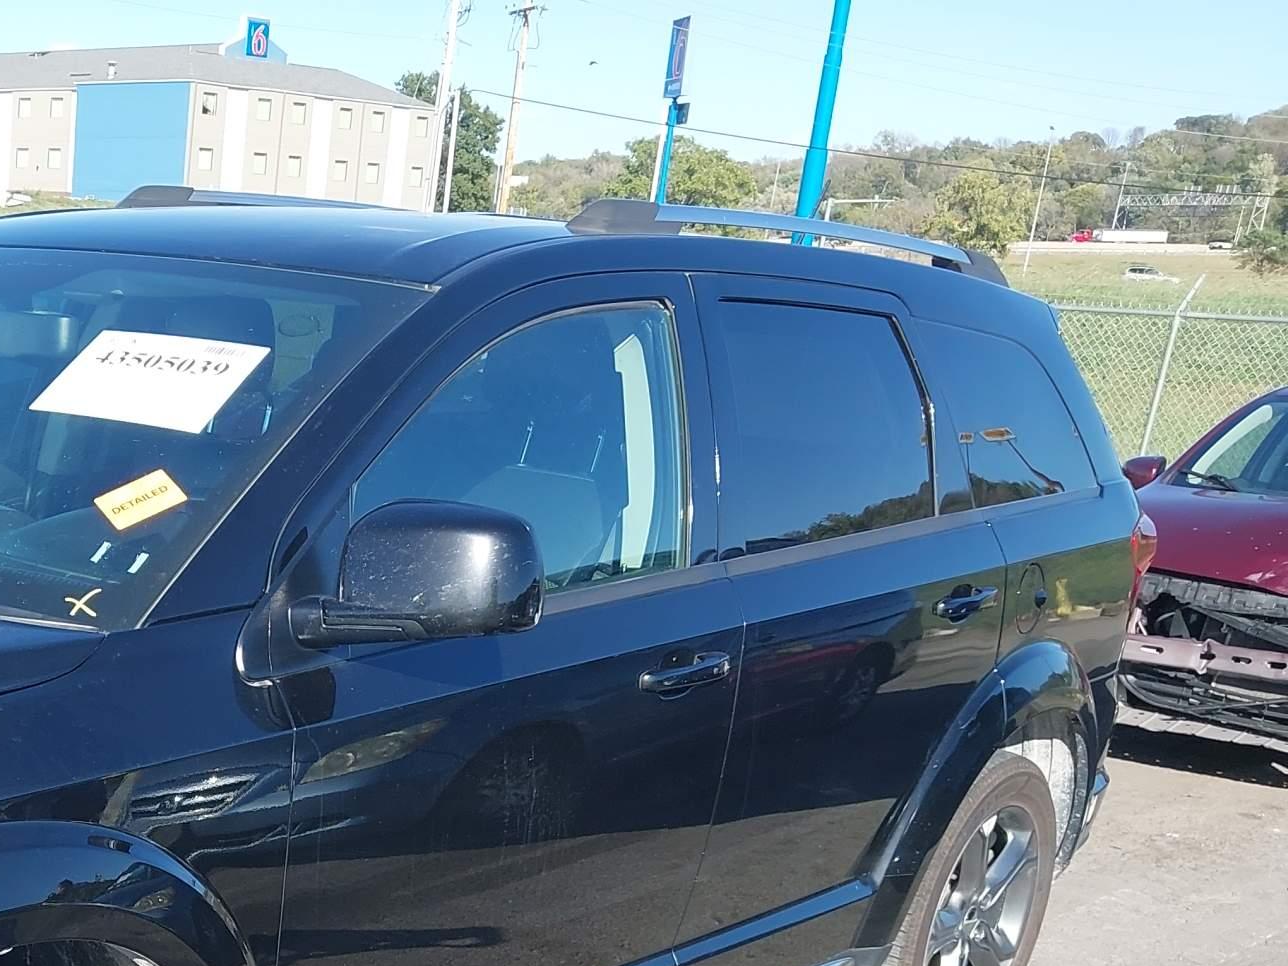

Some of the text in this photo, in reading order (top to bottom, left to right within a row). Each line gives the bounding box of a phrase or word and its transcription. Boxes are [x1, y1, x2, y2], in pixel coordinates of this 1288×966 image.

[252, 24, 267, 57] 6
[96, 350, 230, 376] 43505039
[111, 485, 169, 515] DETAILED
